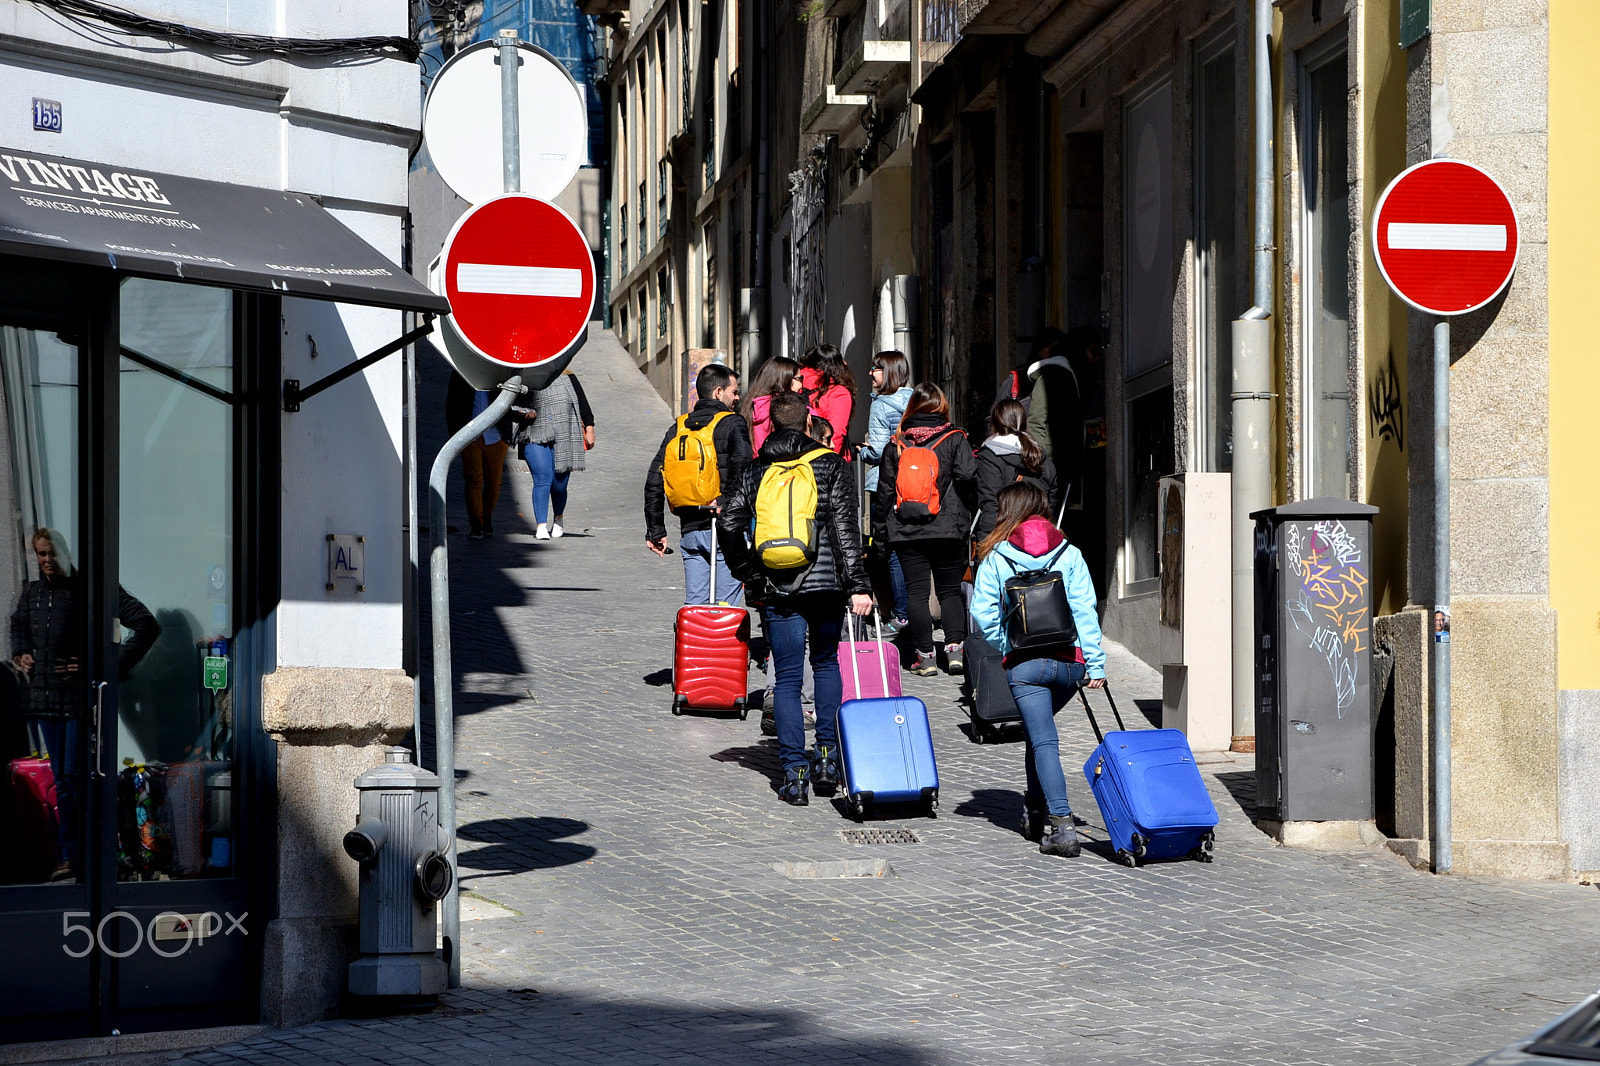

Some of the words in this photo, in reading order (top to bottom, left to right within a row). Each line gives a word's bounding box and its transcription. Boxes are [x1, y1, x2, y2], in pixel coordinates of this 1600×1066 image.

[36, 101, 60, 129] 155
[0, 155, 172, 206] VINTAGE
[20, 196, 80, 213] SERVICED
[82, 204, 154, 225] APARTMENTS
[151, 216, 193, 229] PORTO
[335, 546, 358, 571] AL
